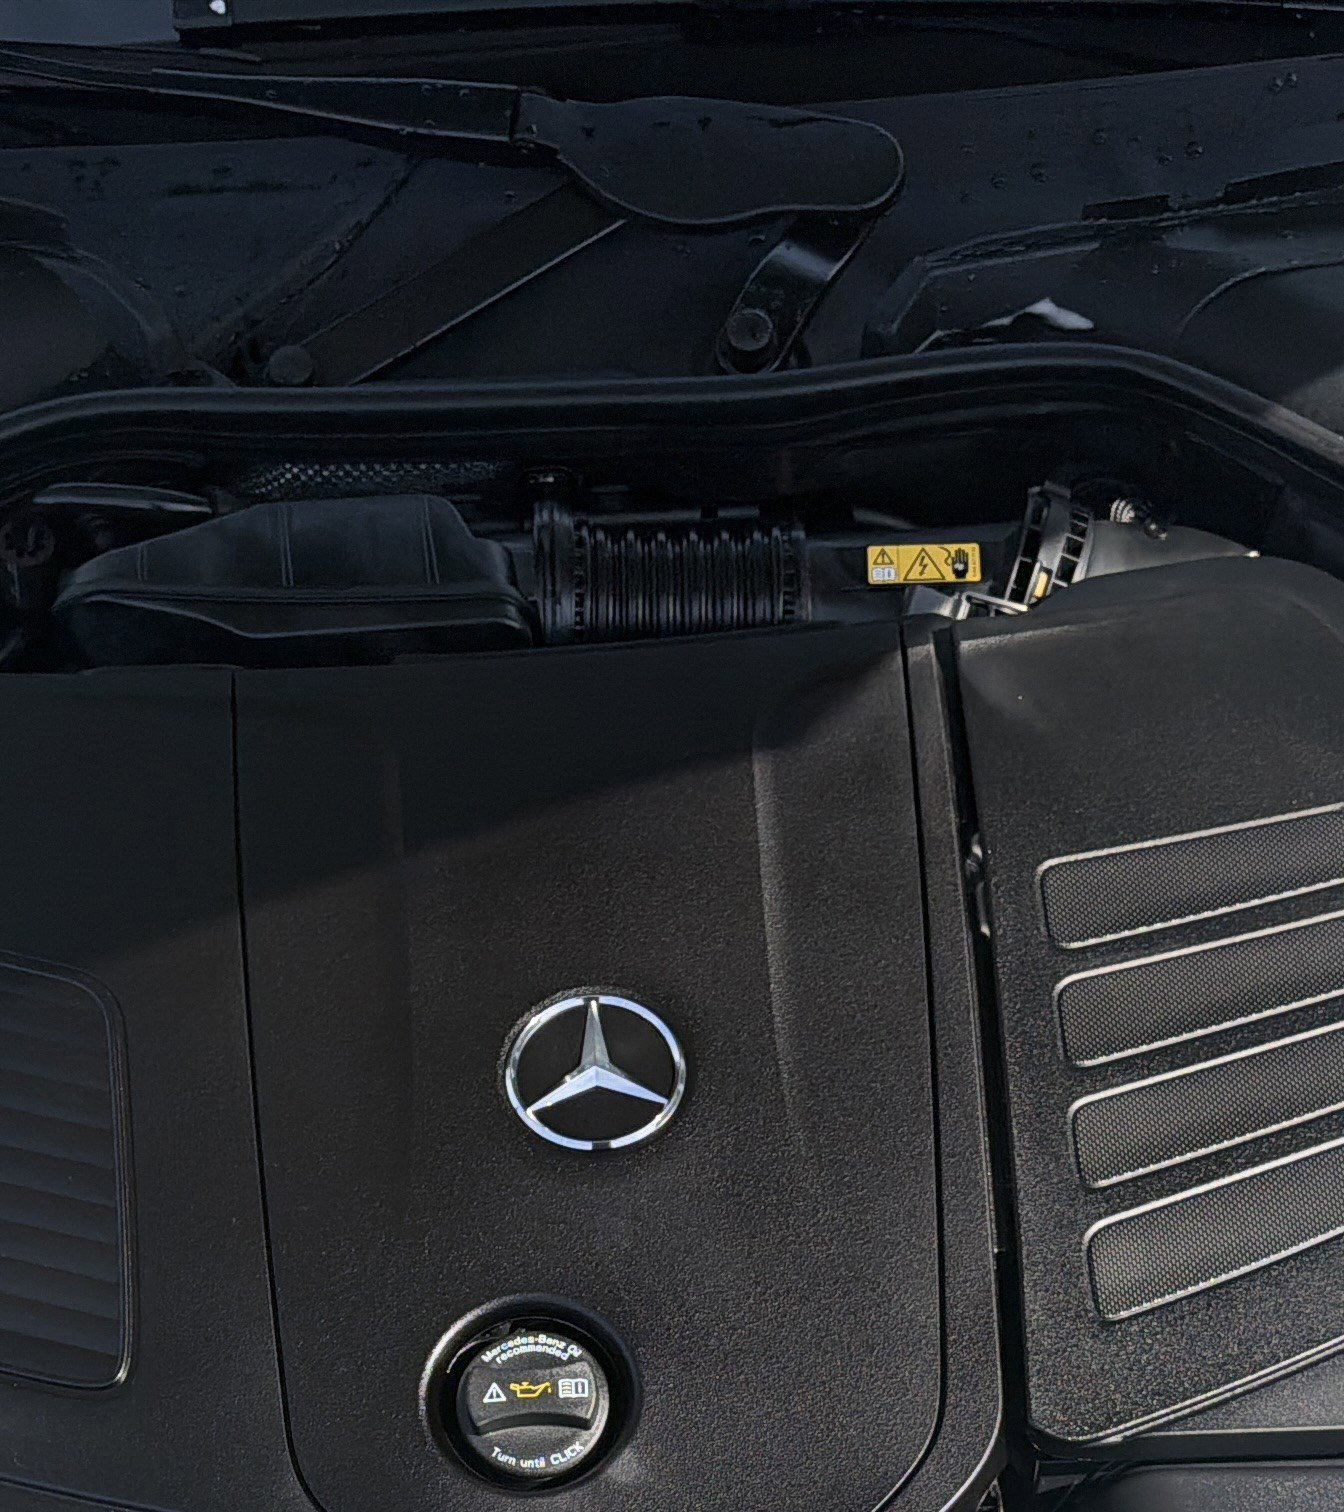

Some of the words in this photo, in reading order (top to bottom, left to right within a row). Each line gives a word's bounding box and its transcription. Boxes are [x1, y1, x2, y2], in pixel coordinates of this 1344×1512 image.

[495, 1343, 570, 1365] recommended
[491, 1446, 517, 1466] Turn
[520, 1456, 546, 1468] until
[550, 1440, 585, 1465] CLICK
